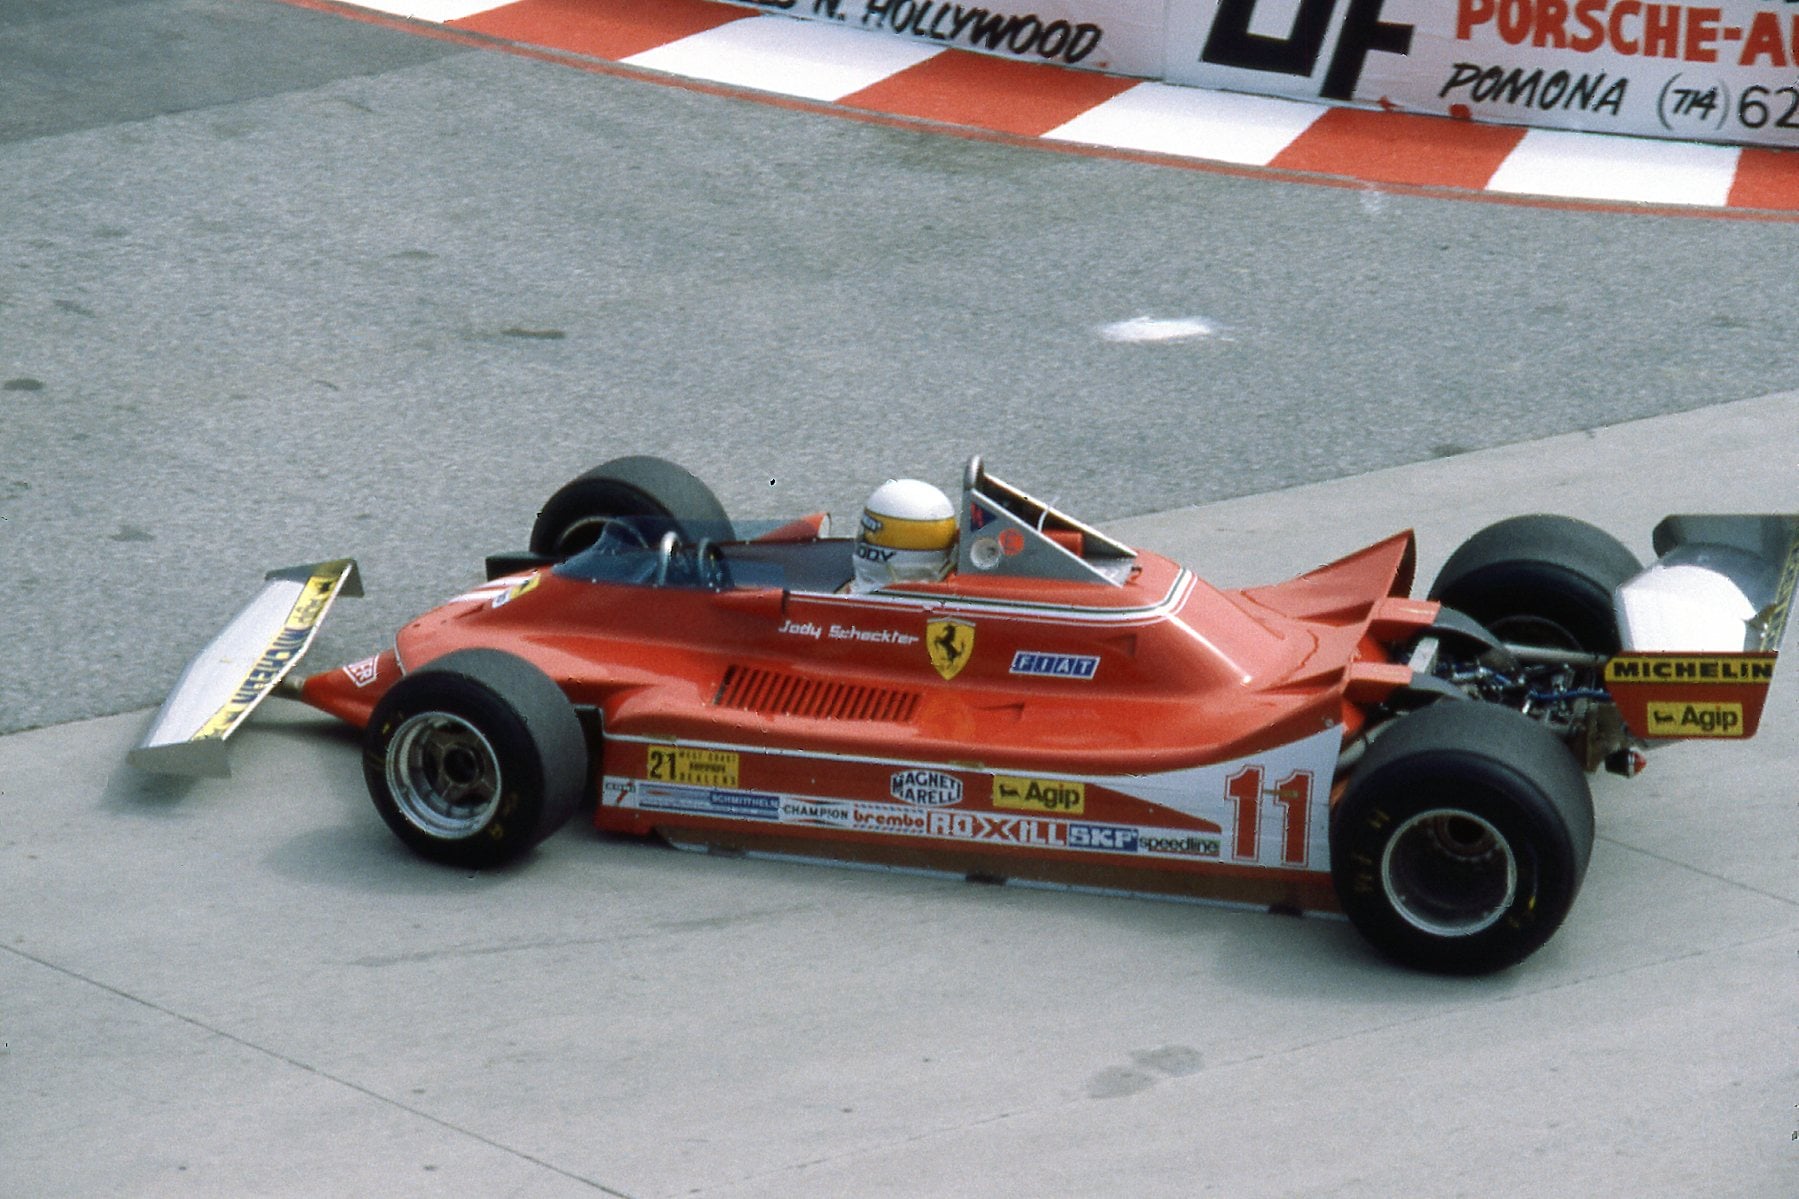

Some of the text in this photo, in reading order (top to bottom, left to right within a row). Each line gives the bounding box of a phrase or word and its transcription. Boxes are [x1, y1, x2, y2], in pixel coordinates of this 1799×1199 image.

[862, 0, 1101, 63] HOLLYWOOD
[1456, 0, 1799, 67] PORSCHE-A
[1438, 62, 1629, 115] POMONA
[778, 619, 920, 645] Jody Scheckter
[1018, 655, 1093, 674] FIAT
[1613, 660, 1773, 678] MICHELIN
[1680, 705, 1738, 731] Agip
[650, 750, 677, 782] 21
[1024, 781, 1080, 809] Agip
[783, 803, 849, 820] CHAMPION
[853, 809, 925, 828] brembo
[1224, 764, 1314, 868] 11
[1070, 824, 1131, 849] SKF
[1139, 835, 1220, 853] speedline
